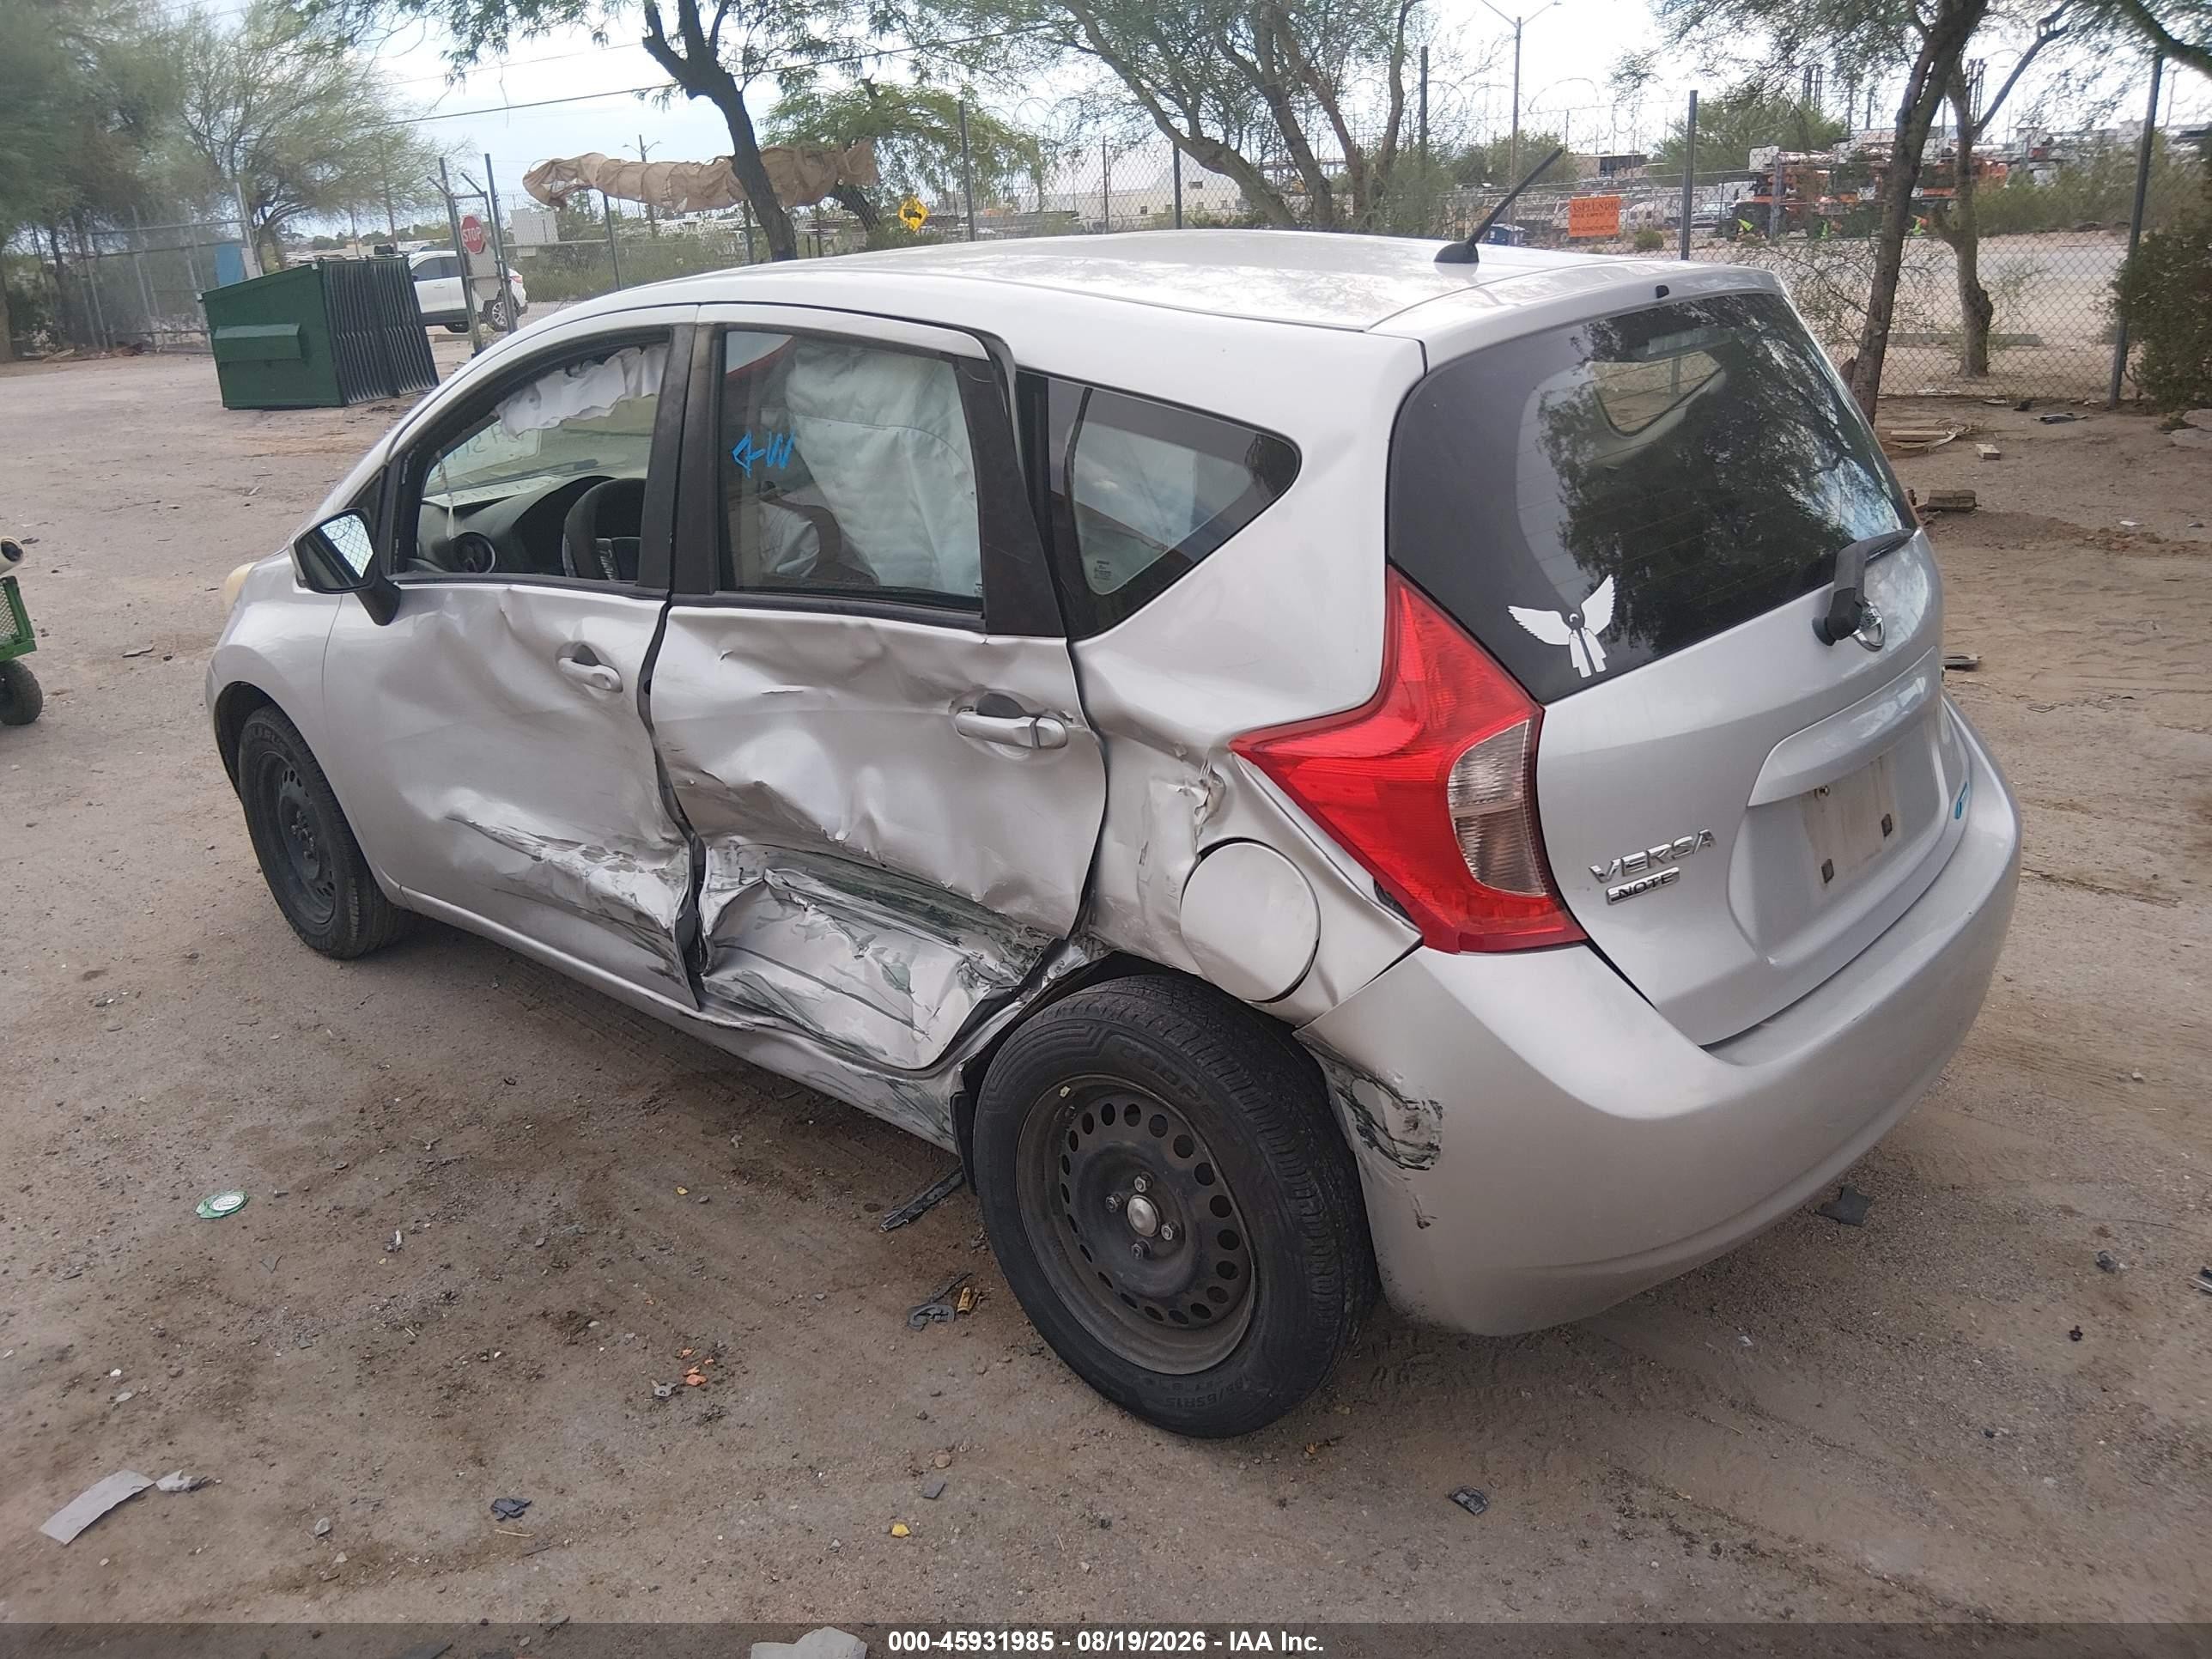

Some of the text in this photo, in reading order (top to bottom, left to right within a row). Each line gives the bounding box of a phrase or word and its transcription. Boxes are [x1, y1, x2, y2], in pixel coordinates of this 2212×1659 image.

[463, 226, 482, 241] STOP
[1589, 829, 1717, 884] VERSA
[1613, 871, 1674, 901] NOTE
